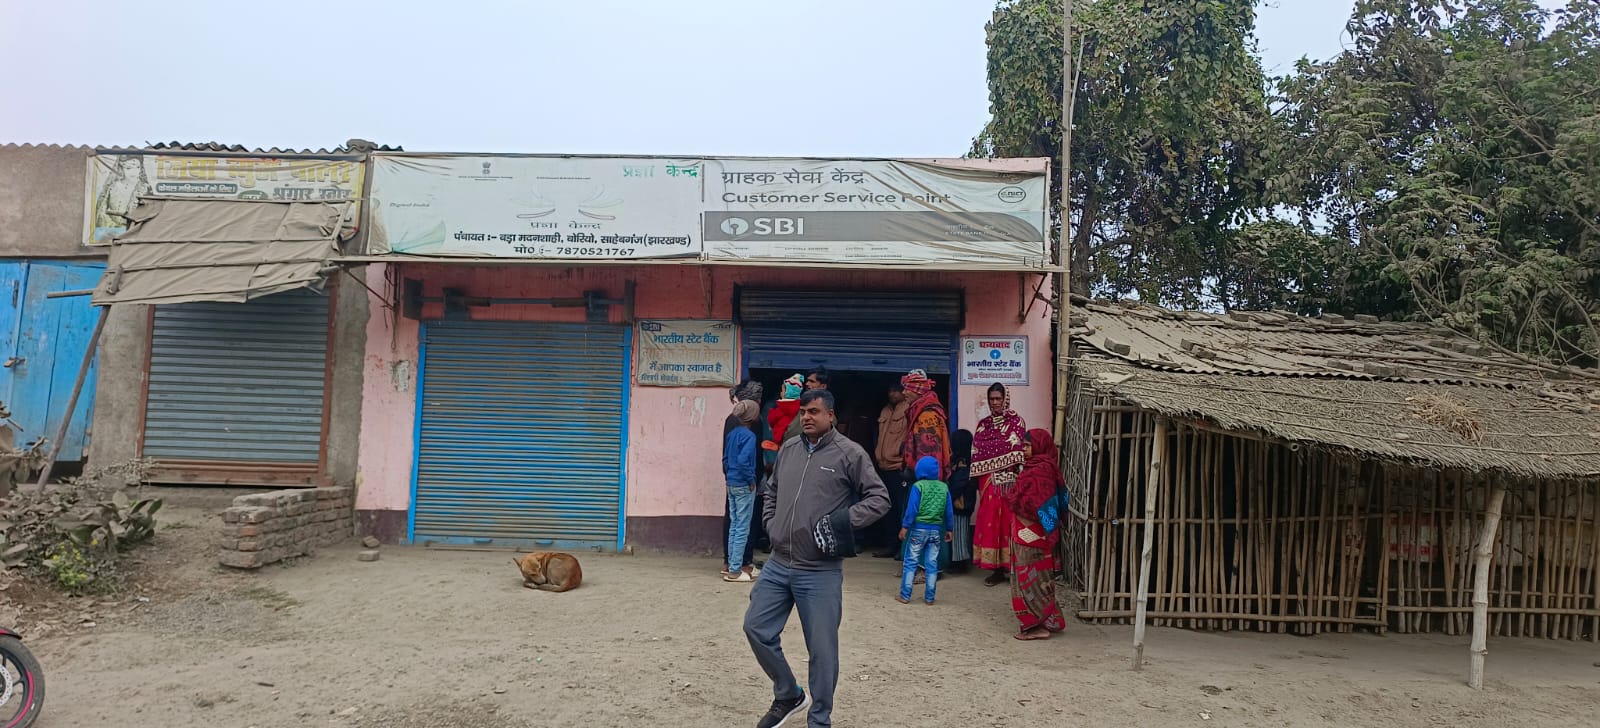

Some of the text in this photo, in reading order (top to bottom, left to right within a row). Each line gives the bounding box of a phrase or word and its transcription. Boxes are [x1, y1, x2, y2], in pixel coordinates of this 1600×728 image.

[721, 168, 865, 185] ग्राहक सेवा केंद्र
[722, 192, 951, 204] Customer Service Point
[753, 217, 804, 235] SBI
[454, 231, 485, 242] पंचायत
[557, 247, 636, 256] 7870521767
[653, 332, 684, 343] भारतीय
[687, 333, 702, 343] स्टेट
[649, 361, 723, 373] में आपका स्वागत है
